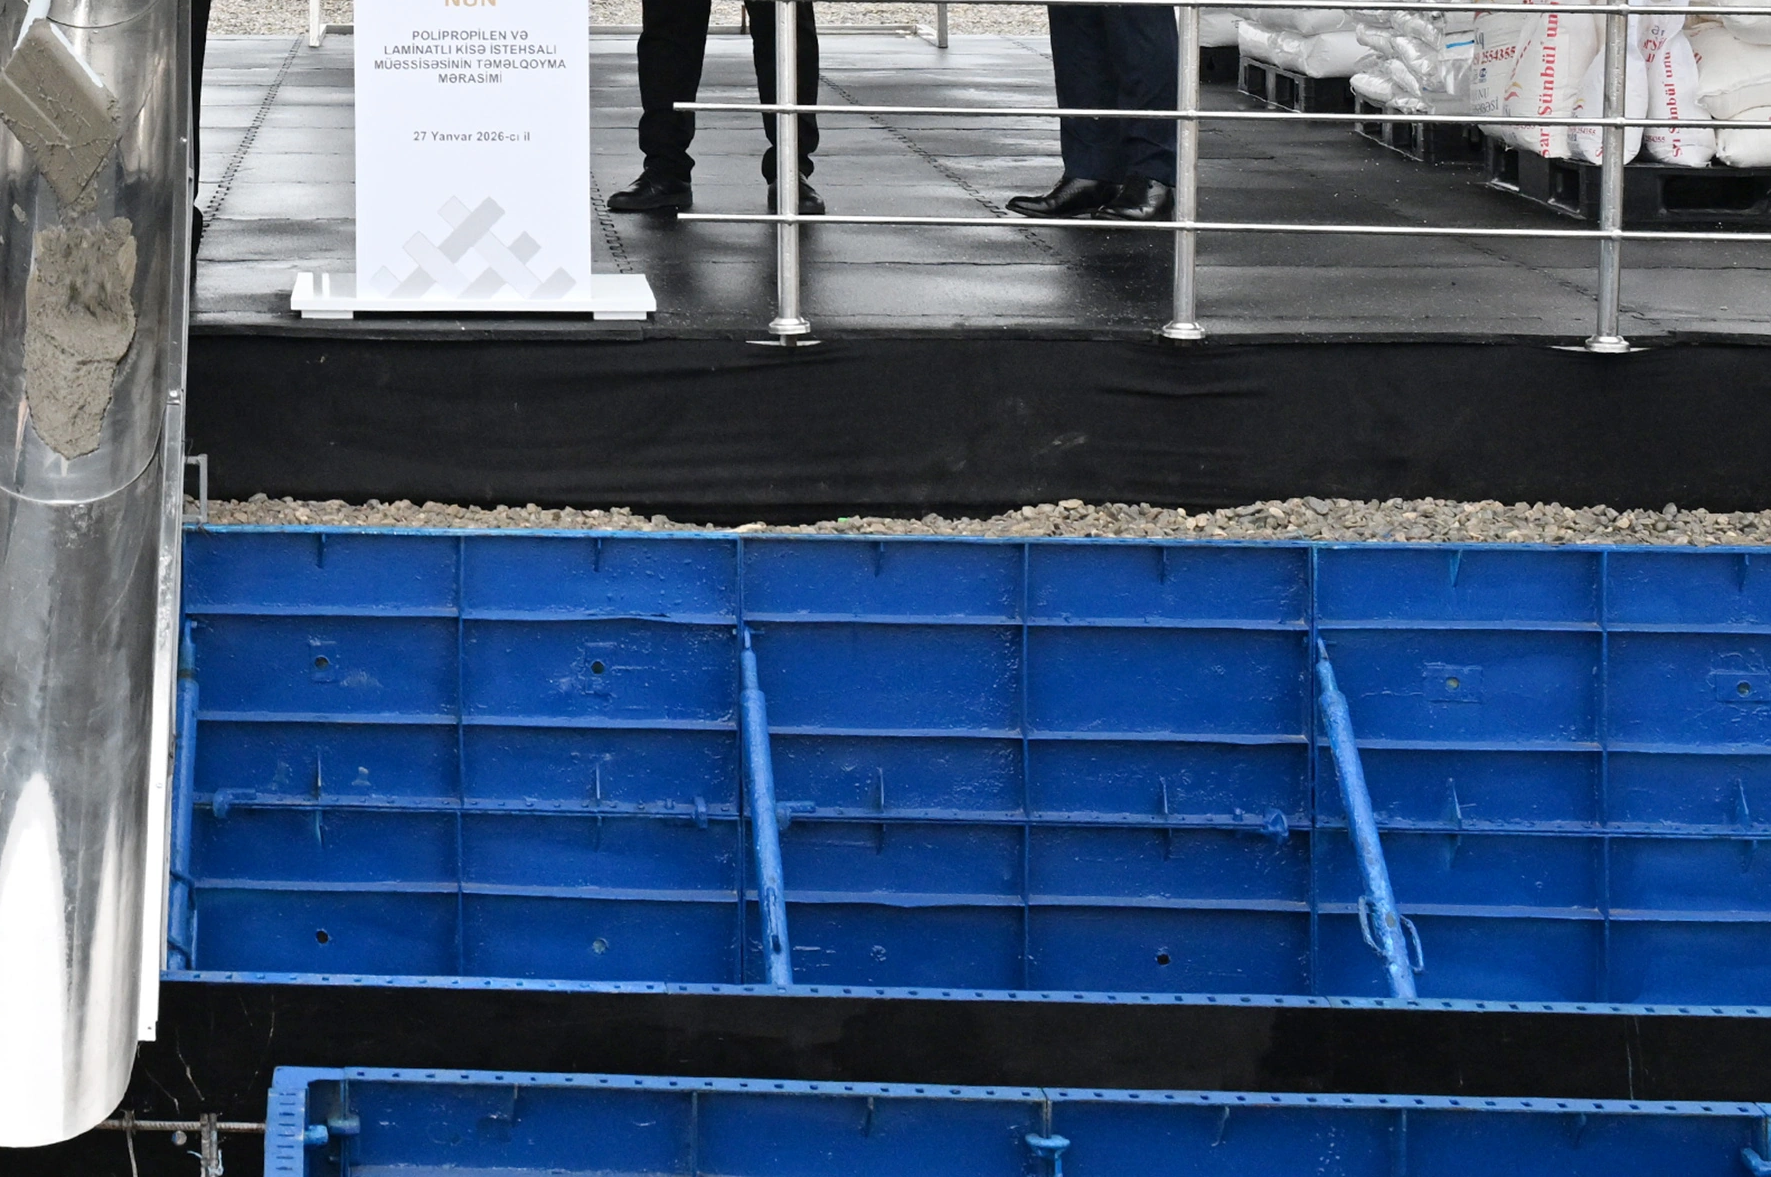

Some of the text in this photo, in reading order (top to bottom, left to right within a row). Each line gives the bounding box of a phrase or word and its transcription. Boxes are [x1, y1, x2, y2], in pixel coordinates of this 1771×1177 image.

[412, 28, 528, 41] POLİPROPİLEN VƏ
[384, 43, 556, 55] LAMİNATLI KİSƏ İSTEHSALI
[375, 58, 566, 70] MÜƏSSİSƏSİNİN TƏMƏLQOYMA
[438, 71, 502, 83] MƏRASİMİ
[1537, 46, 1557, 117] Sünbül
[413, 131, 530, 142] 27 Yanvar 2026-cı il
